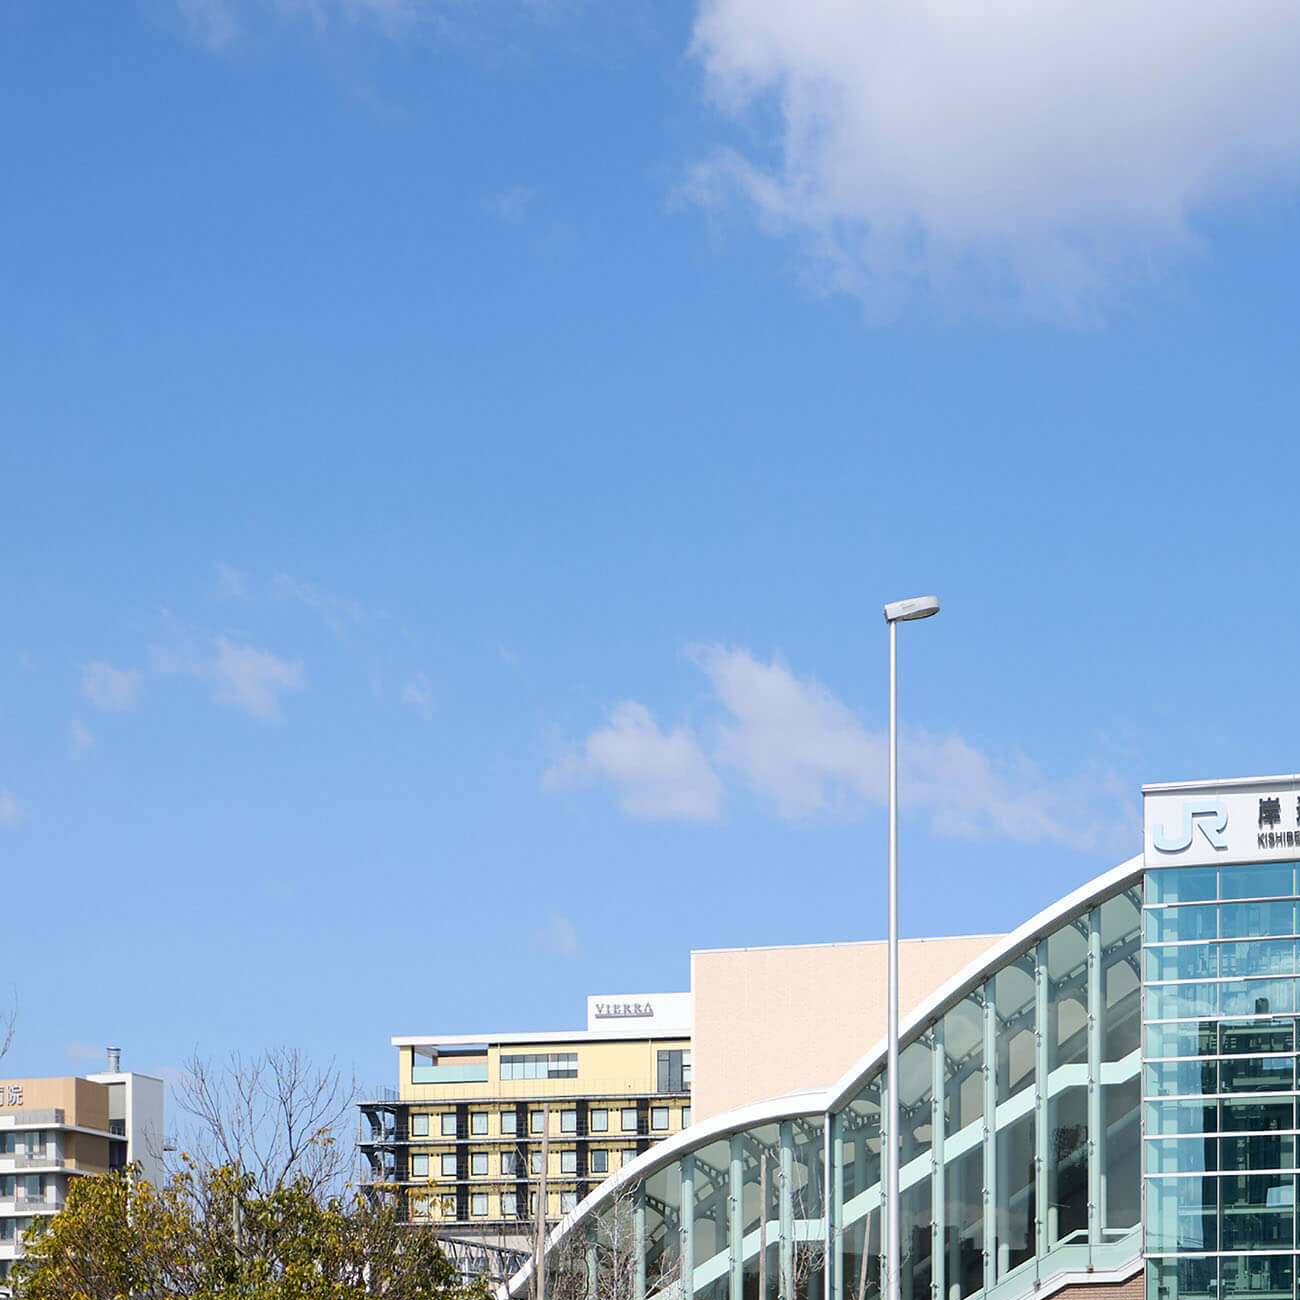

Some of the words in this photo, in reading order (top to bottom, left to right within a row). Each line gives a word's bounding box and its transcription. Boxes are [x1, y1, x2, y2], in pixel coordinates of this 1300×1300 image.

[1153, 801, 1229, 854] JR
[1257, 830, 1300, 849] KISHIBE
[595, 1002, 654, 1019] VIERRA
[0, 1085, 24, 1107] 院
